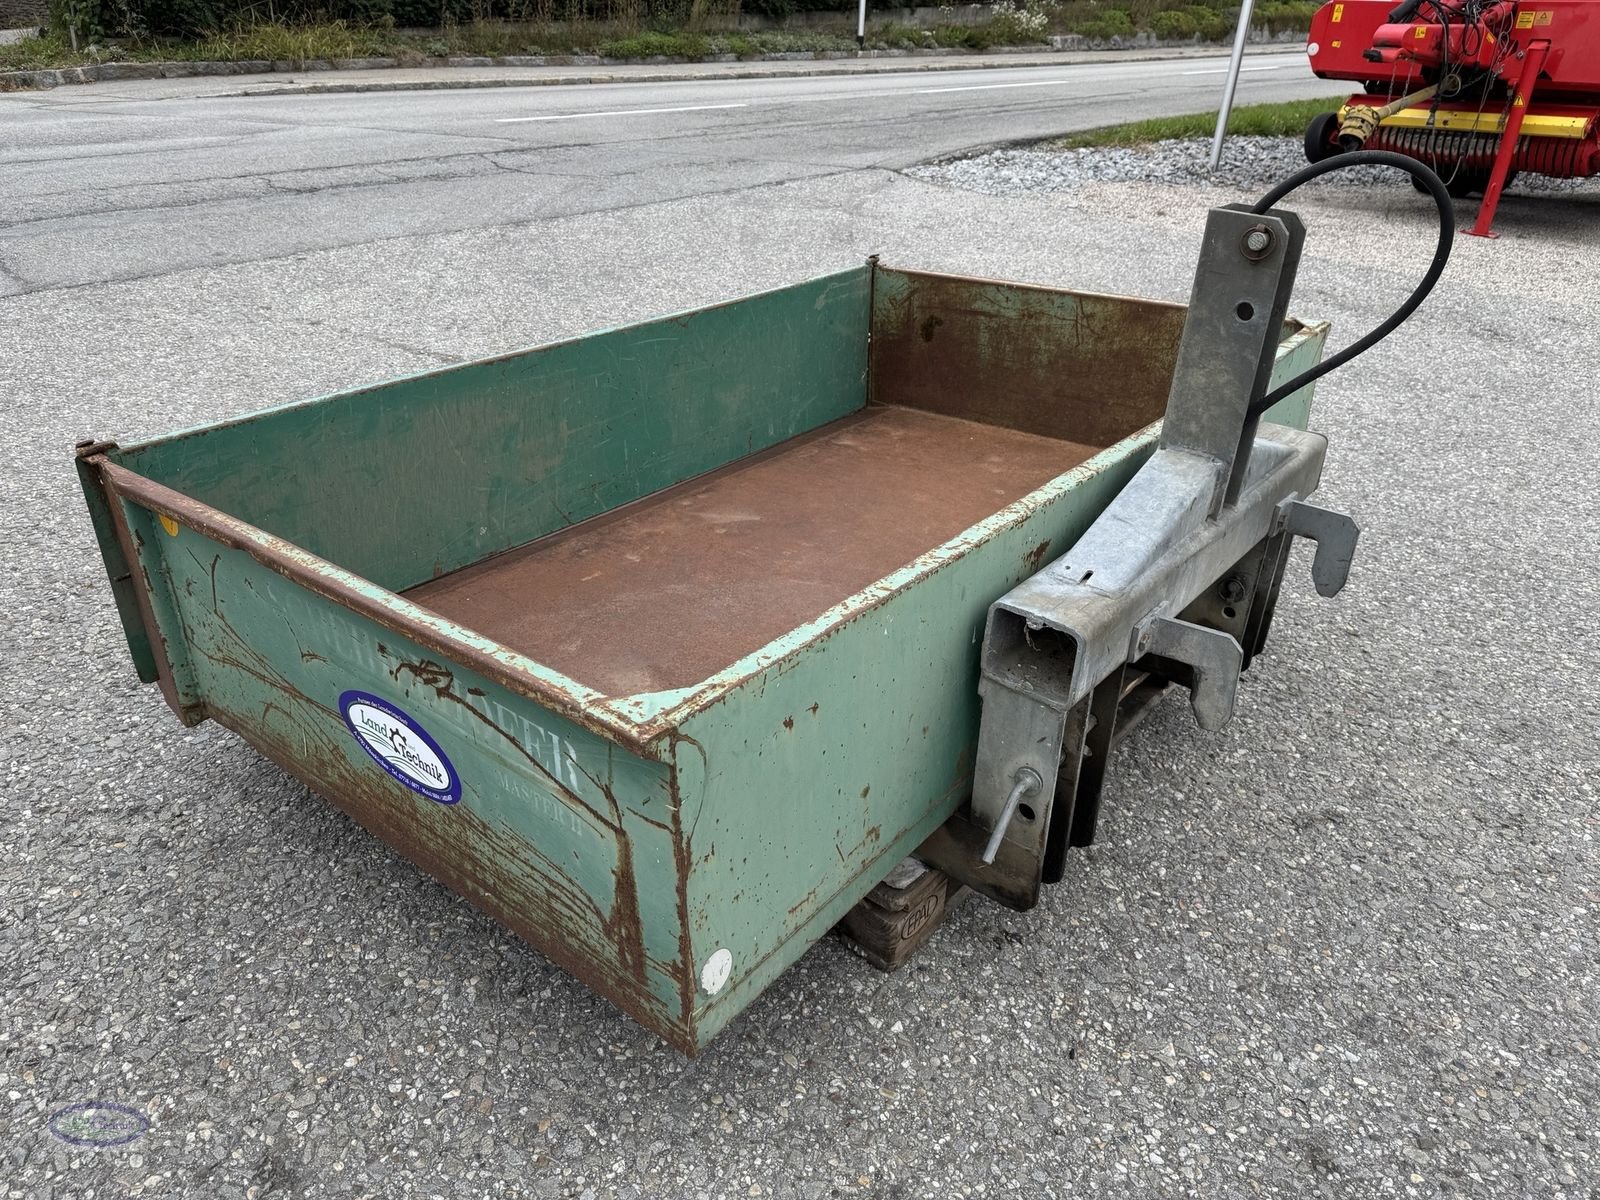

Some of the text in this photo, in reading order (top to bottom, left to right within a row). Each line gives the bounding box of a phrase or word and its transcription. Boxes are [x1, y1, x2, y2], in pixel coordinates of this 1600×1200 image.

[360, 709, 388, 738] Land
[398, 742, 443, 784] Technik
[497, 770, 563, 823] MASTER
